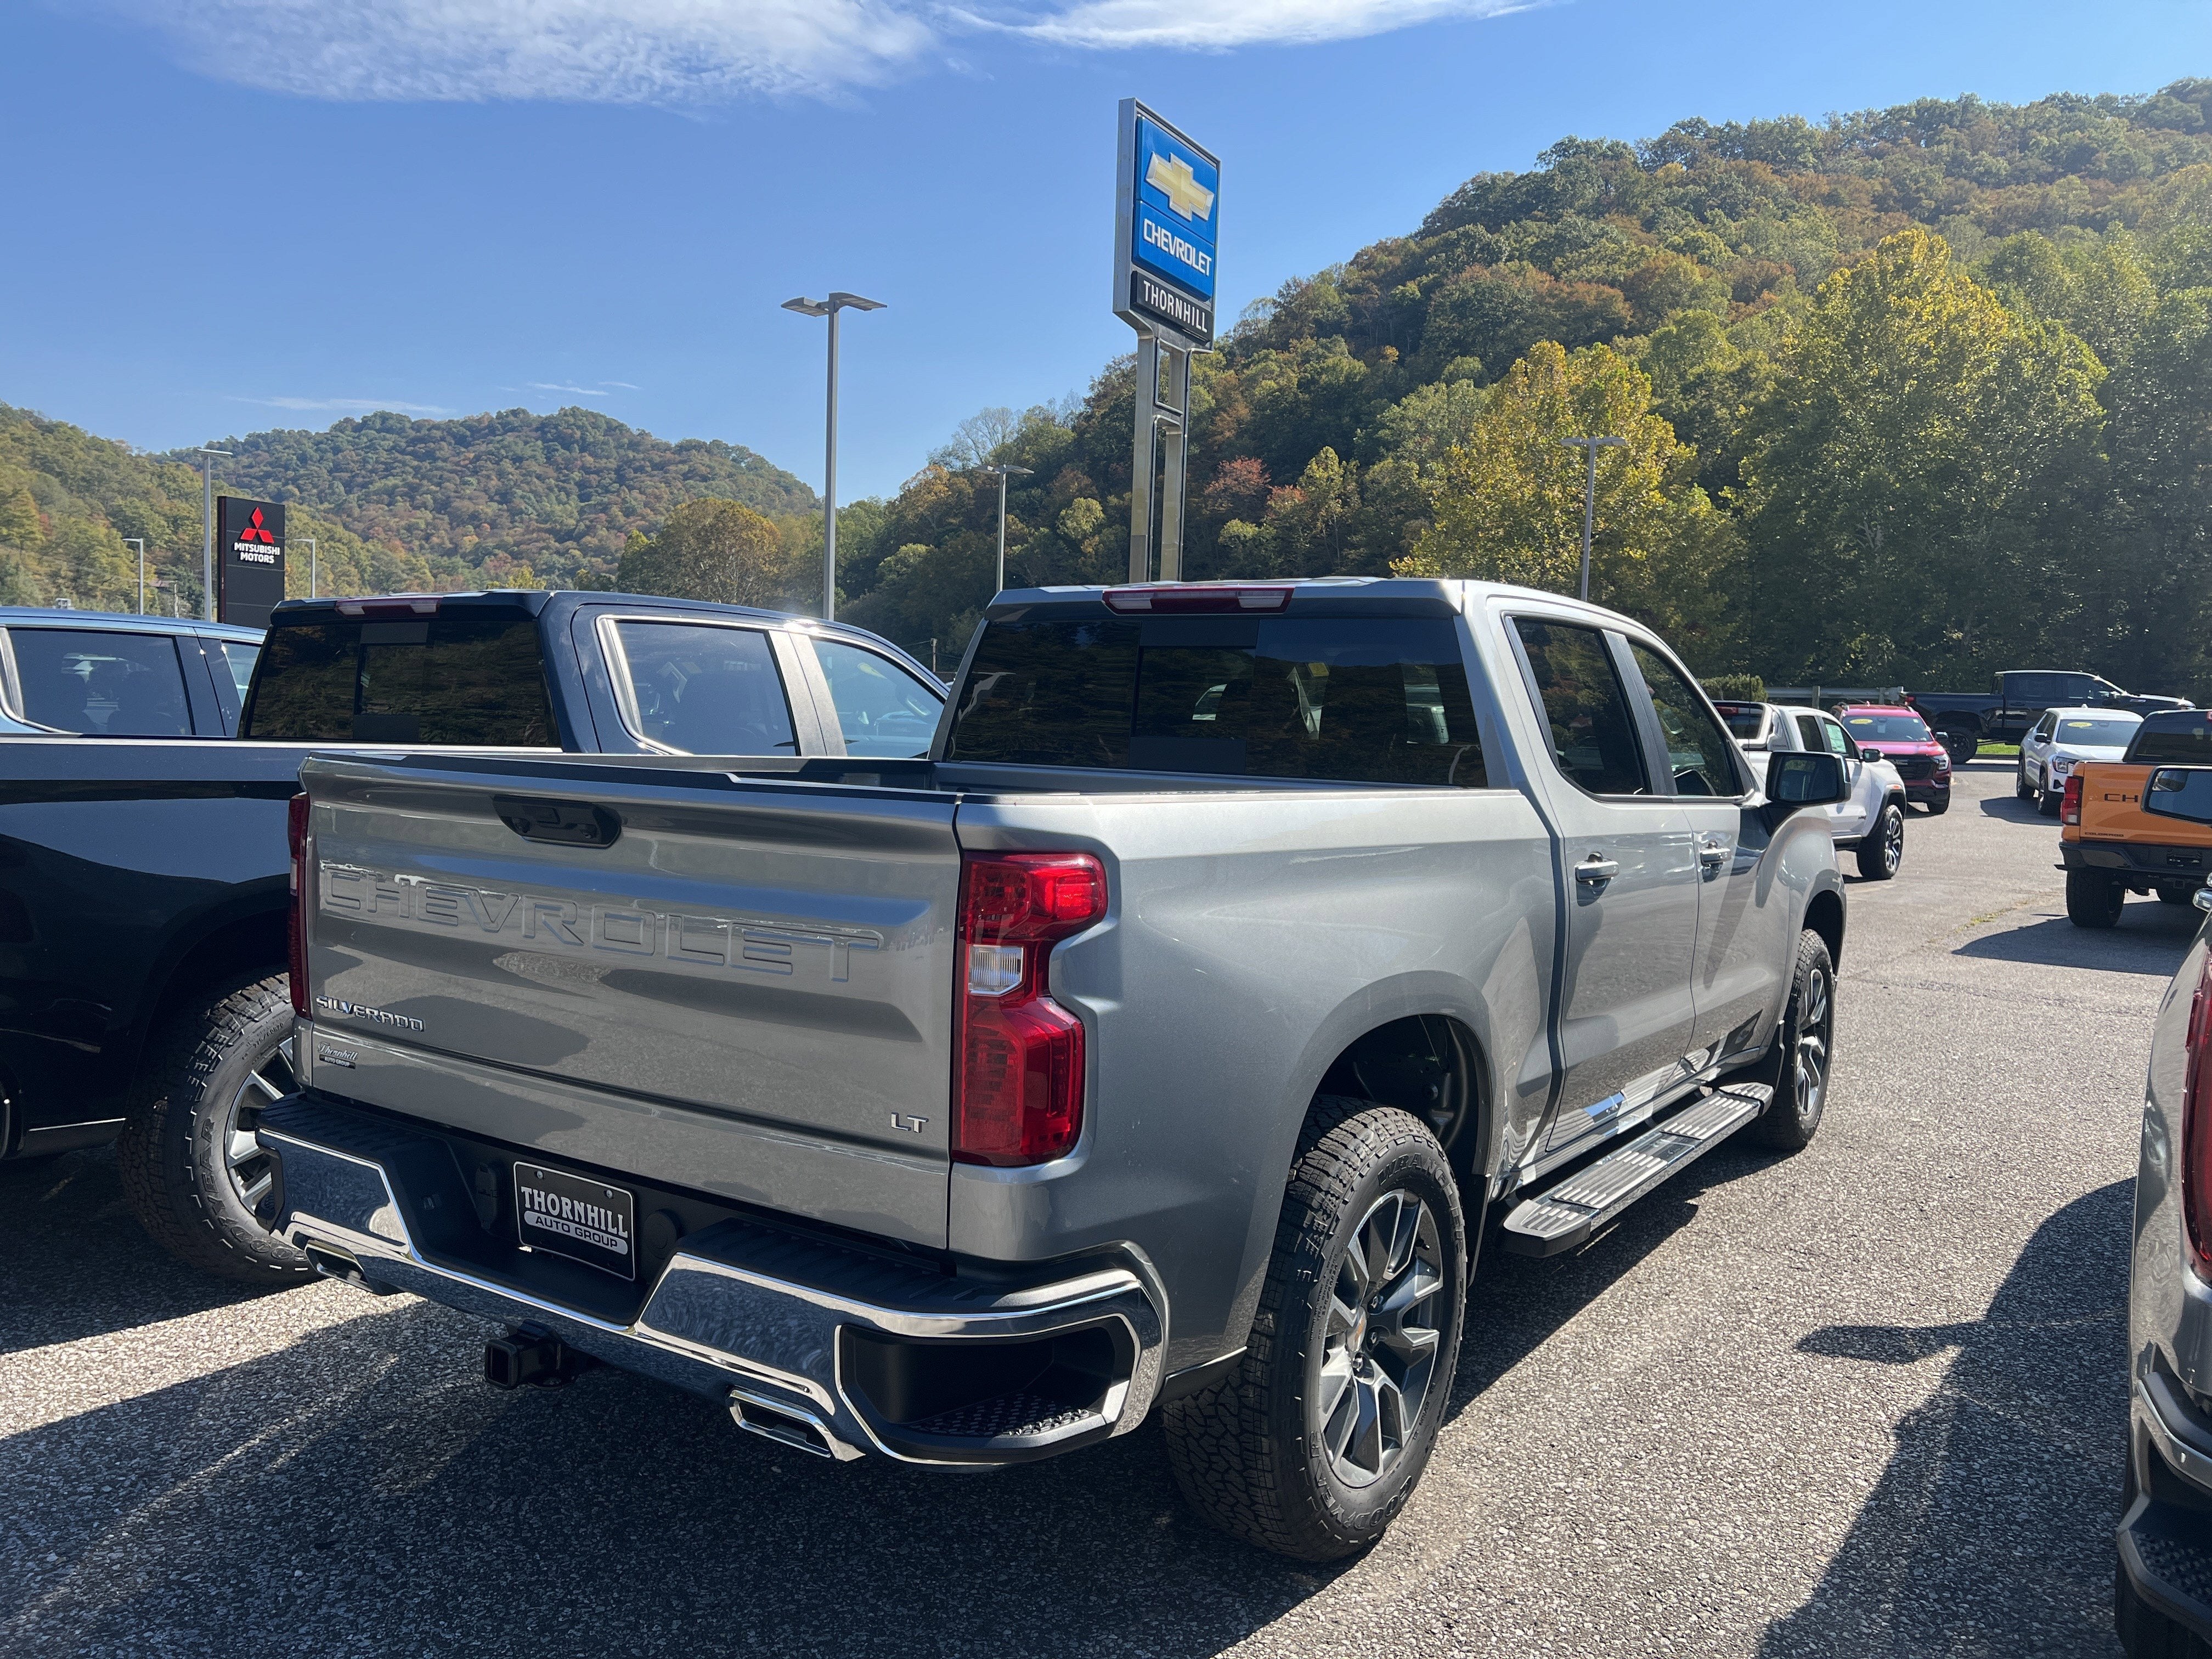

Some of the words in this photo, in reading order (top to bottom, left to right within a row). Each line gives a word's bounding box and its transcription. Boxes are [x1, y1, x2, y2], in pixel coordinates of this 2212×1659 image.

[1143, 218, 1212, 276] CHEVROLET
[1143, 280, 1207, 333] THORNHILL
[234, 542, 280, 555] MITSUBISHI
[240, 551, 275, 564] MOTORS
[323, 864, 884, 983] CHEVROLET
[315, 995, 425, 1032] SILVERADO
[317, 1041, 359, 1061] Thornhill
[890, 1111, 929, 1133] LT
[521, 1186, 628, 1238] THORNHILL
[535, 1216, 571, 1233] AUTO
[574, 1227, 618, 1248] GROUP
